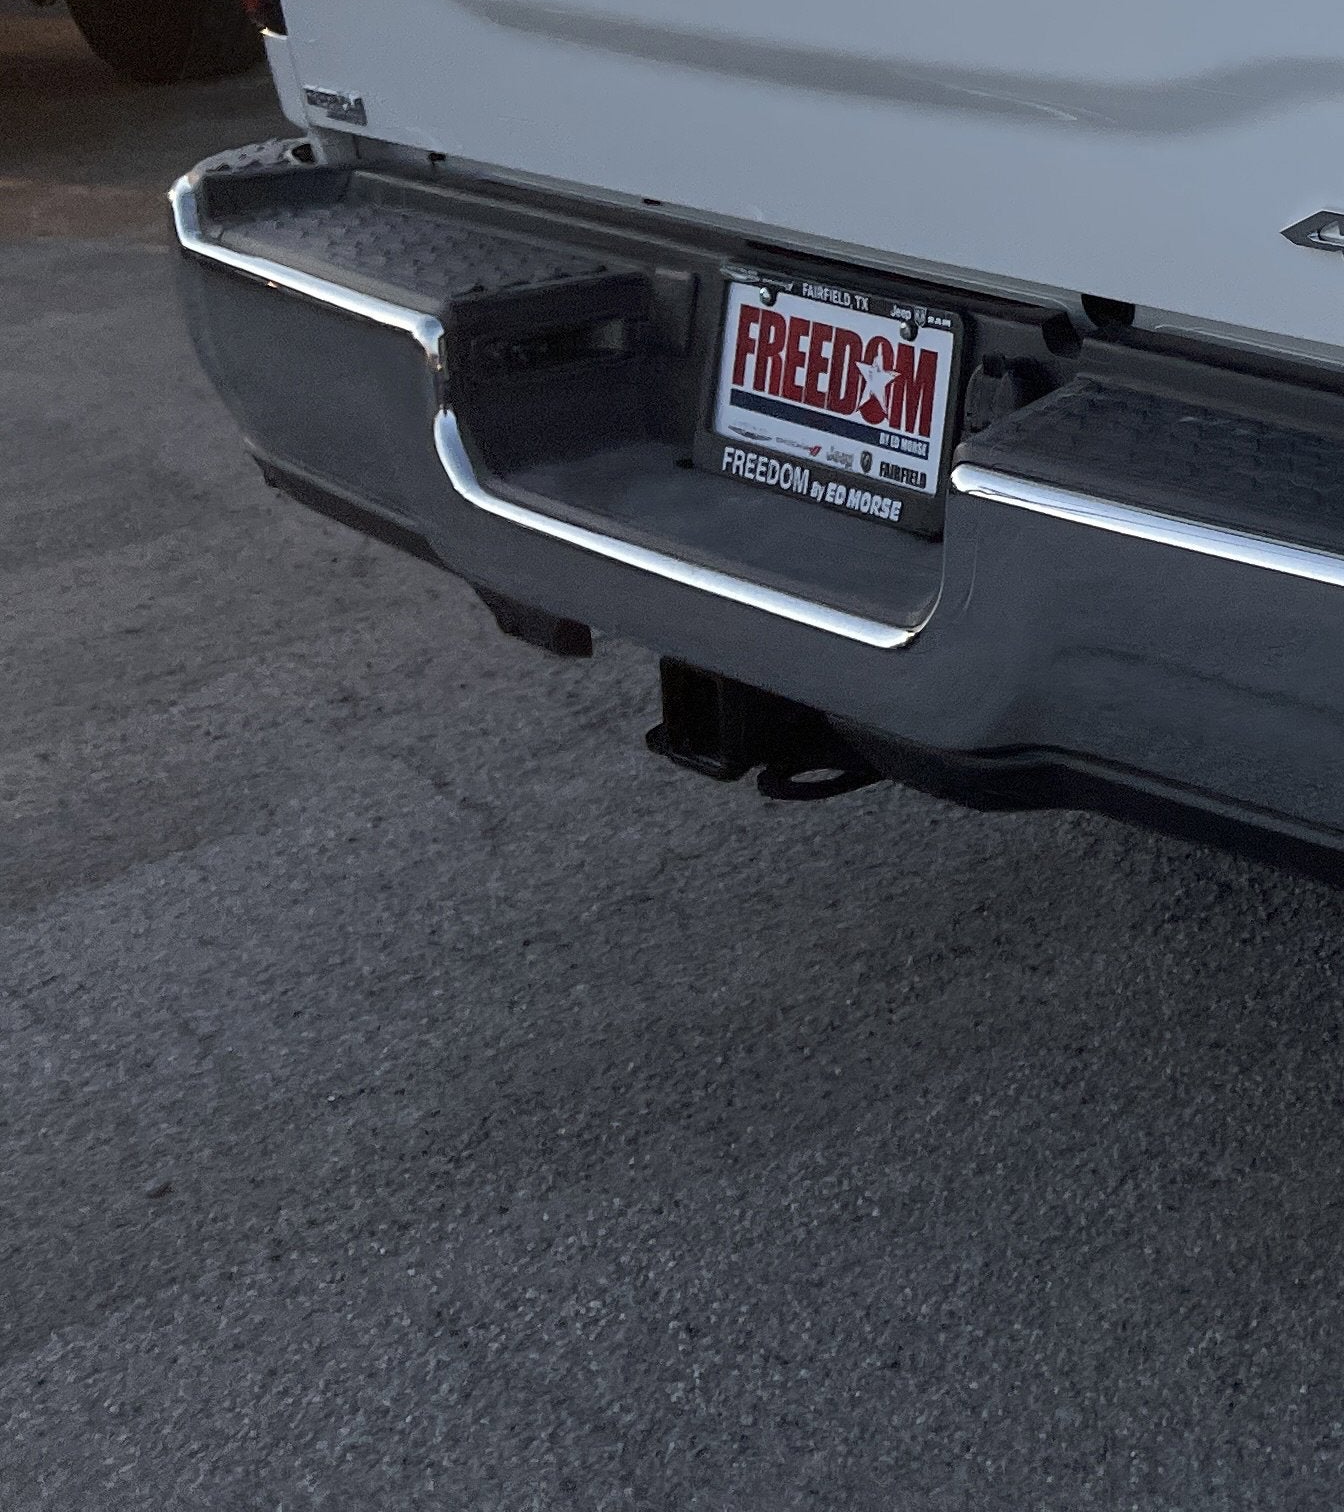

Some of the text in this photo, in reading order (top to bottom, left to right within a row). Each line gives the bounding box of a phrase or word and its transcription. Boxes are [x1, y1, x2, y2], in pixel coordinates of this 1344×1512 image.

[802, 282, 853, 309] FAIRFIELD,
[854, 295, 870, 312] TX
[890, 305, 912, 320] Jeep
[732, 303, 939, 438] FREEDOM
[722, 446, 810, 496] FREEDOM
[825, 481, 847, 505] ED
[846, 488, 903, 522] MORSE
[880, 461, 927, 489] FAIRFIELD
